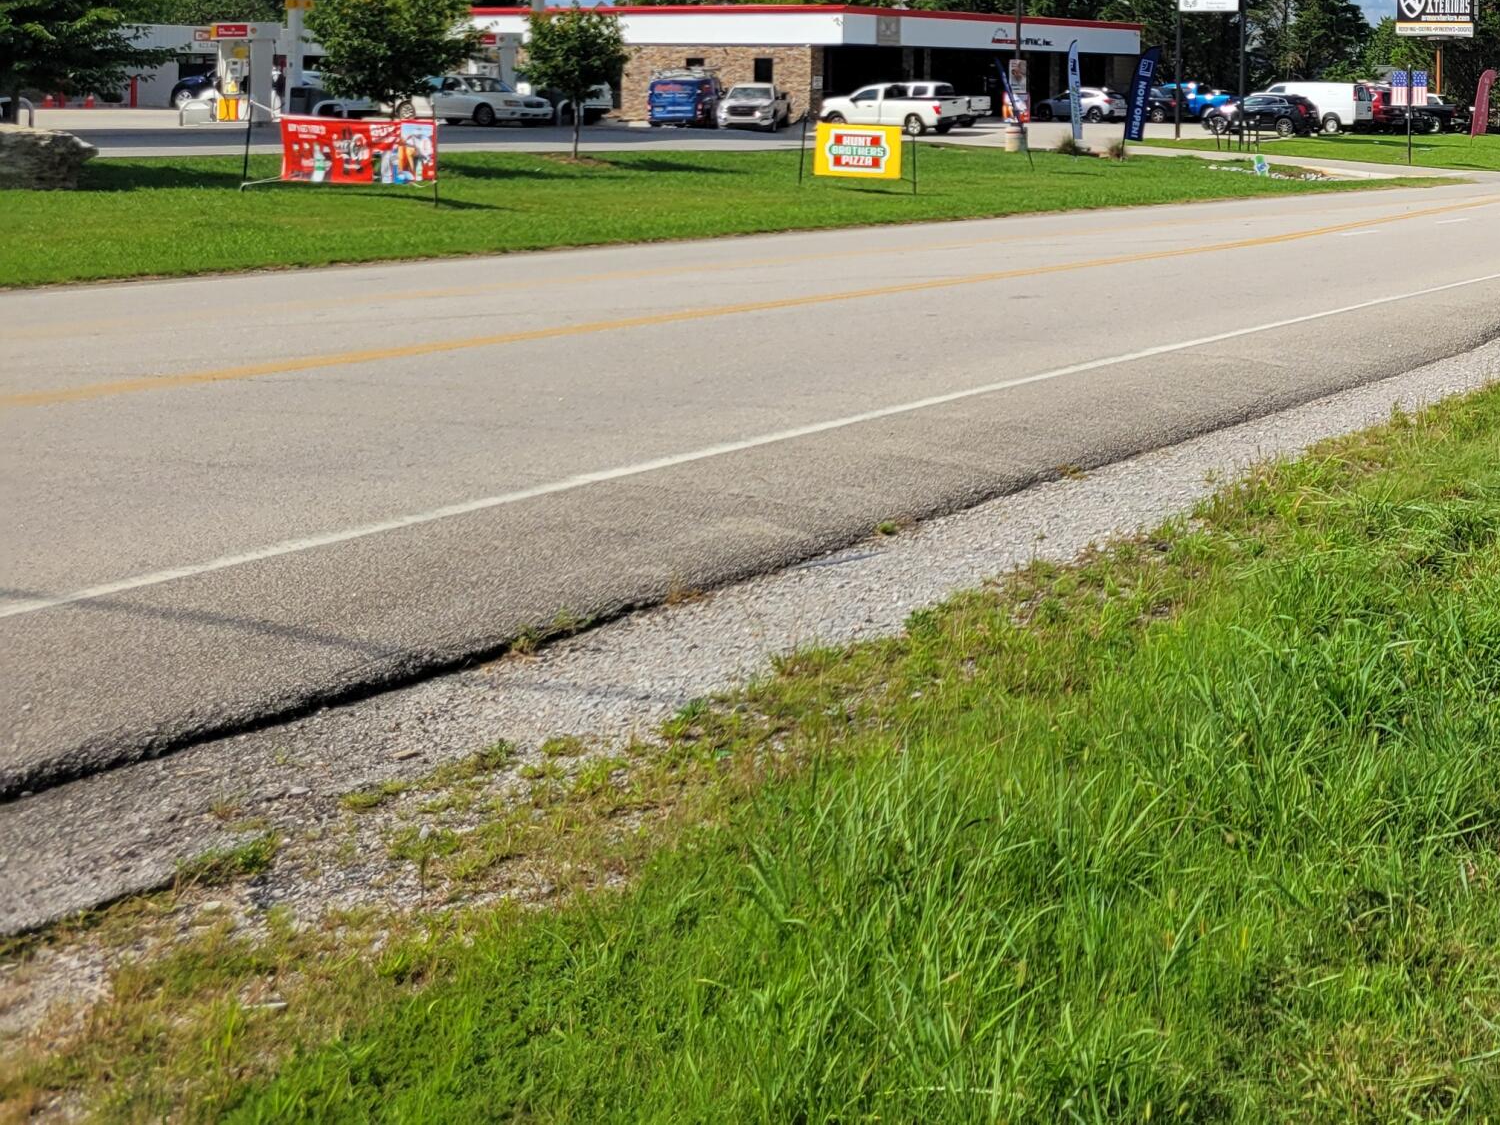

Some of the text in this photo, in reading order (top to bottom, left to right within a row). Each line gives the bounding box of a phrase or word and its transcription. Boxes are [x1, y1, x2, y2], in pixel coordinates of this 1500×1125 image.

[1131, 81, 1147, 138] NOW OPEN!
[842, 135, 872, 146] HUNT
[830, 145, 885, 156] BROTHERS
[841, 155, 872, 166] PIZZA
